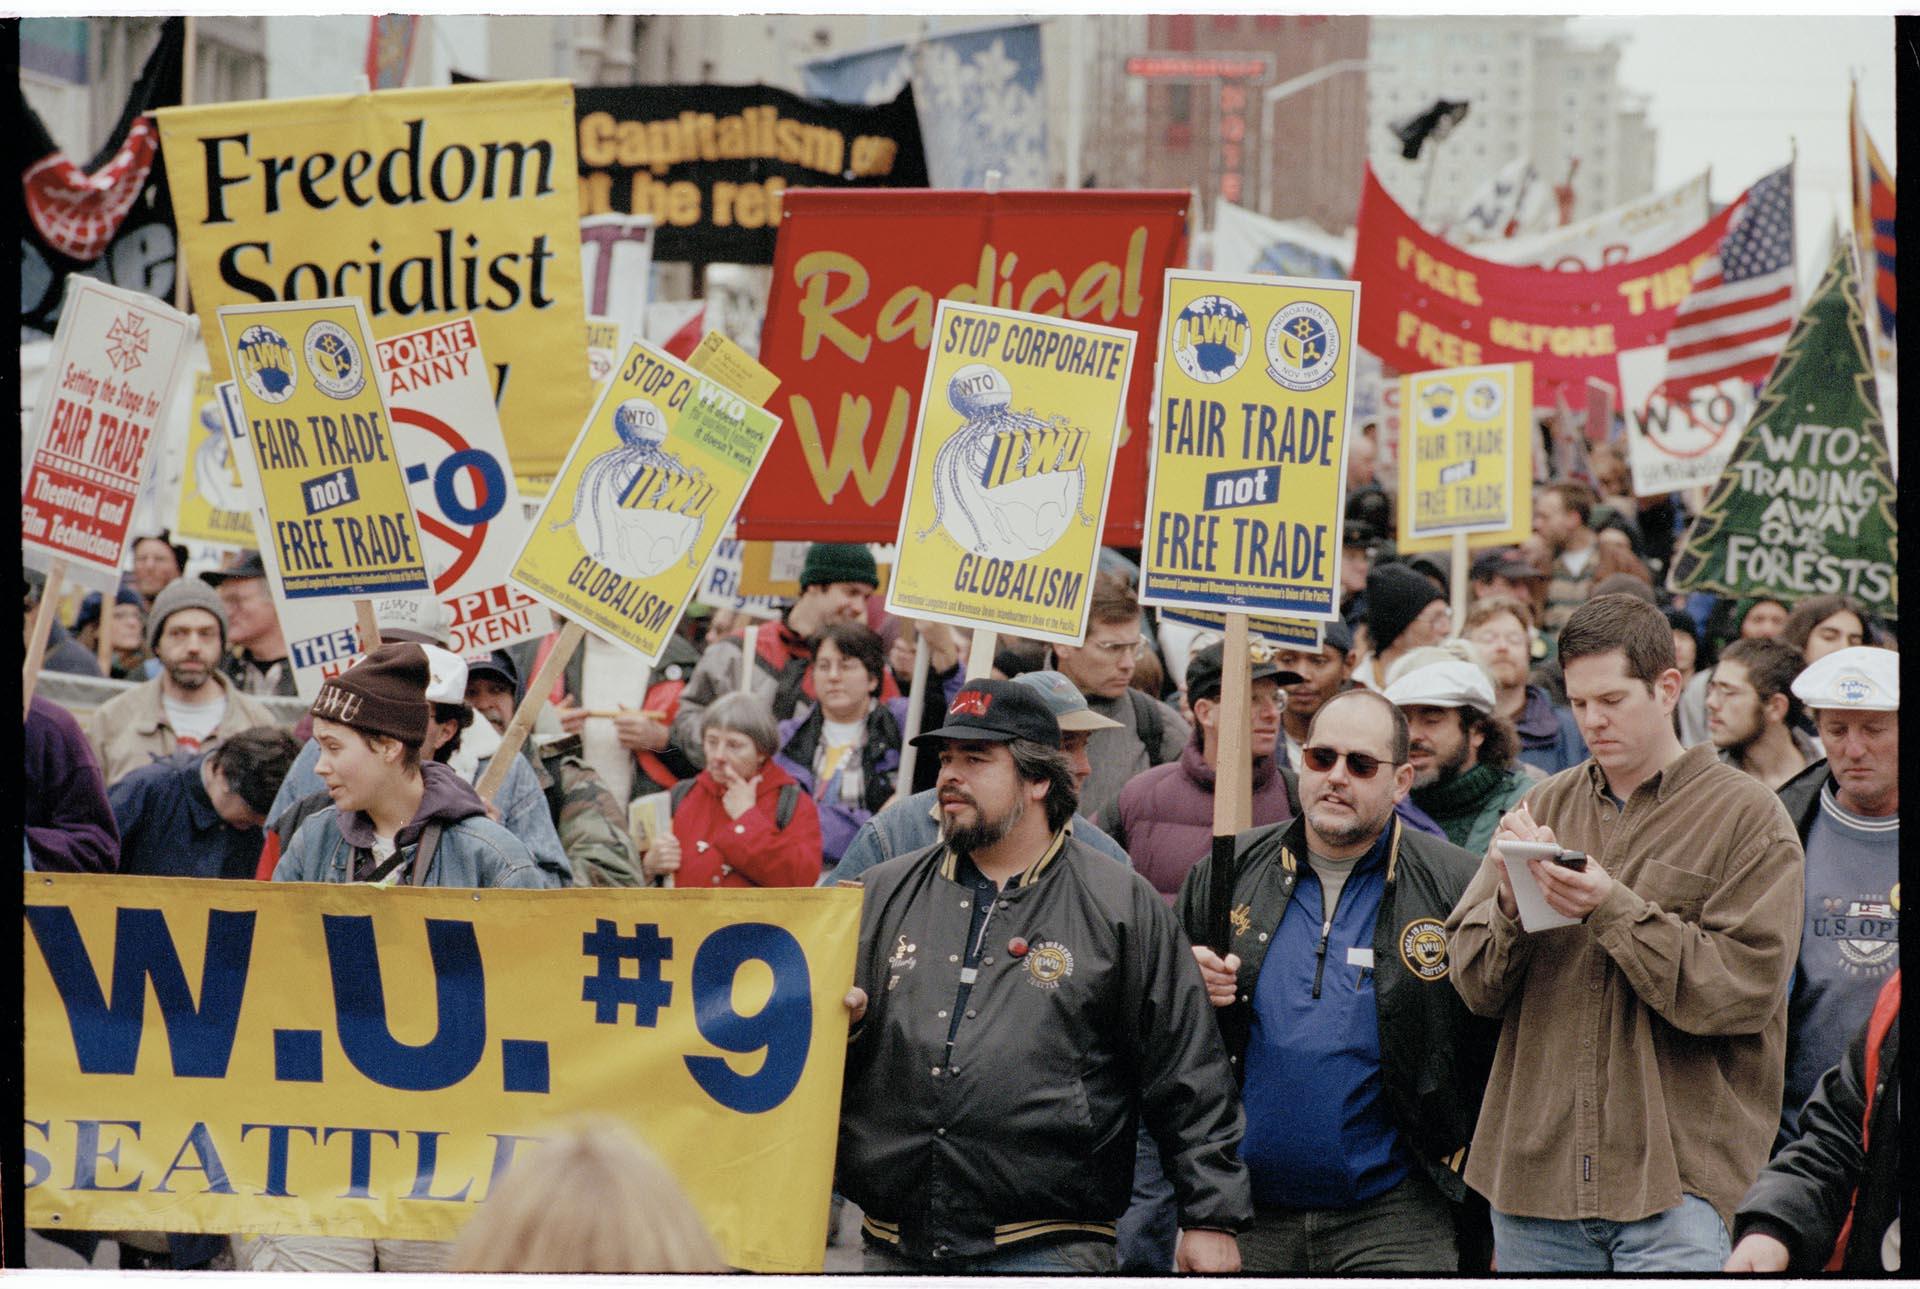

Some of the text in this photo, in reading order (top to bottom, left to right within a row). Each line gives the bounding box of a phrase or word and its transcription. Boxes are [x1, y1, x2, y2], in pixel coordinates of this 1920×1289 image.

[580, 105, 844, 175] Capitalism
[199, 120, 554, 224] Freedom
[631, 171, 702, 227] be
[218, 229, 555, 316] Socialist
[794, 226, 1148, 363] Radical
[1397, 236, 1483, 306] FREE
[243, 342, 294, 380] ILWU
[377, 323, 471, 371] PORATE
[945, 316, 1124, 380] STOP CORPORATE
[1178, 314, 1246, 356] ILWU
[1397, 311, 1482, 367] FREE
[389, 352, 469, 396] ANNY
[623, 353, 675, 396] STOP
[957, 374, 995, 396] WTO
[47, 398, 150, 478] FAIR TRADE
[252, 411, 389, 470] FAIR TRADE
[623, 409, 655, 426] WTO
[1164, 398, 1227, 458] FAIR
[1242, 402, 1336, 466] TRADE
[1633, 394, 1735, 437] WTO
[981, 427, 1090, 489] ILWU
[1759, 423, 1871, 466] WTO:
[33, 470, 127, 527] Theatrical and
[309, 475, 350, 511] not
[1214, 468, 1268, 506] not
[1735, 460, 1878, 508] TRADING
[276, 513, 415, 571] FREE TRADE
[1759, 519, 1829, 555] OUR
[1760, 497, 1870, 538] AWAY
[1156, 511, 1327, 582] FREE TRADE
[1725, 536, 1893, 602] FORESTS
[568, 555, 674, 633] GLOBALISM
[954, 553, 1083, 610] GLOBALISM
[1813, 918, 1853, 938] U.S.
[25, 904, 813, 1114] W.U. #9
